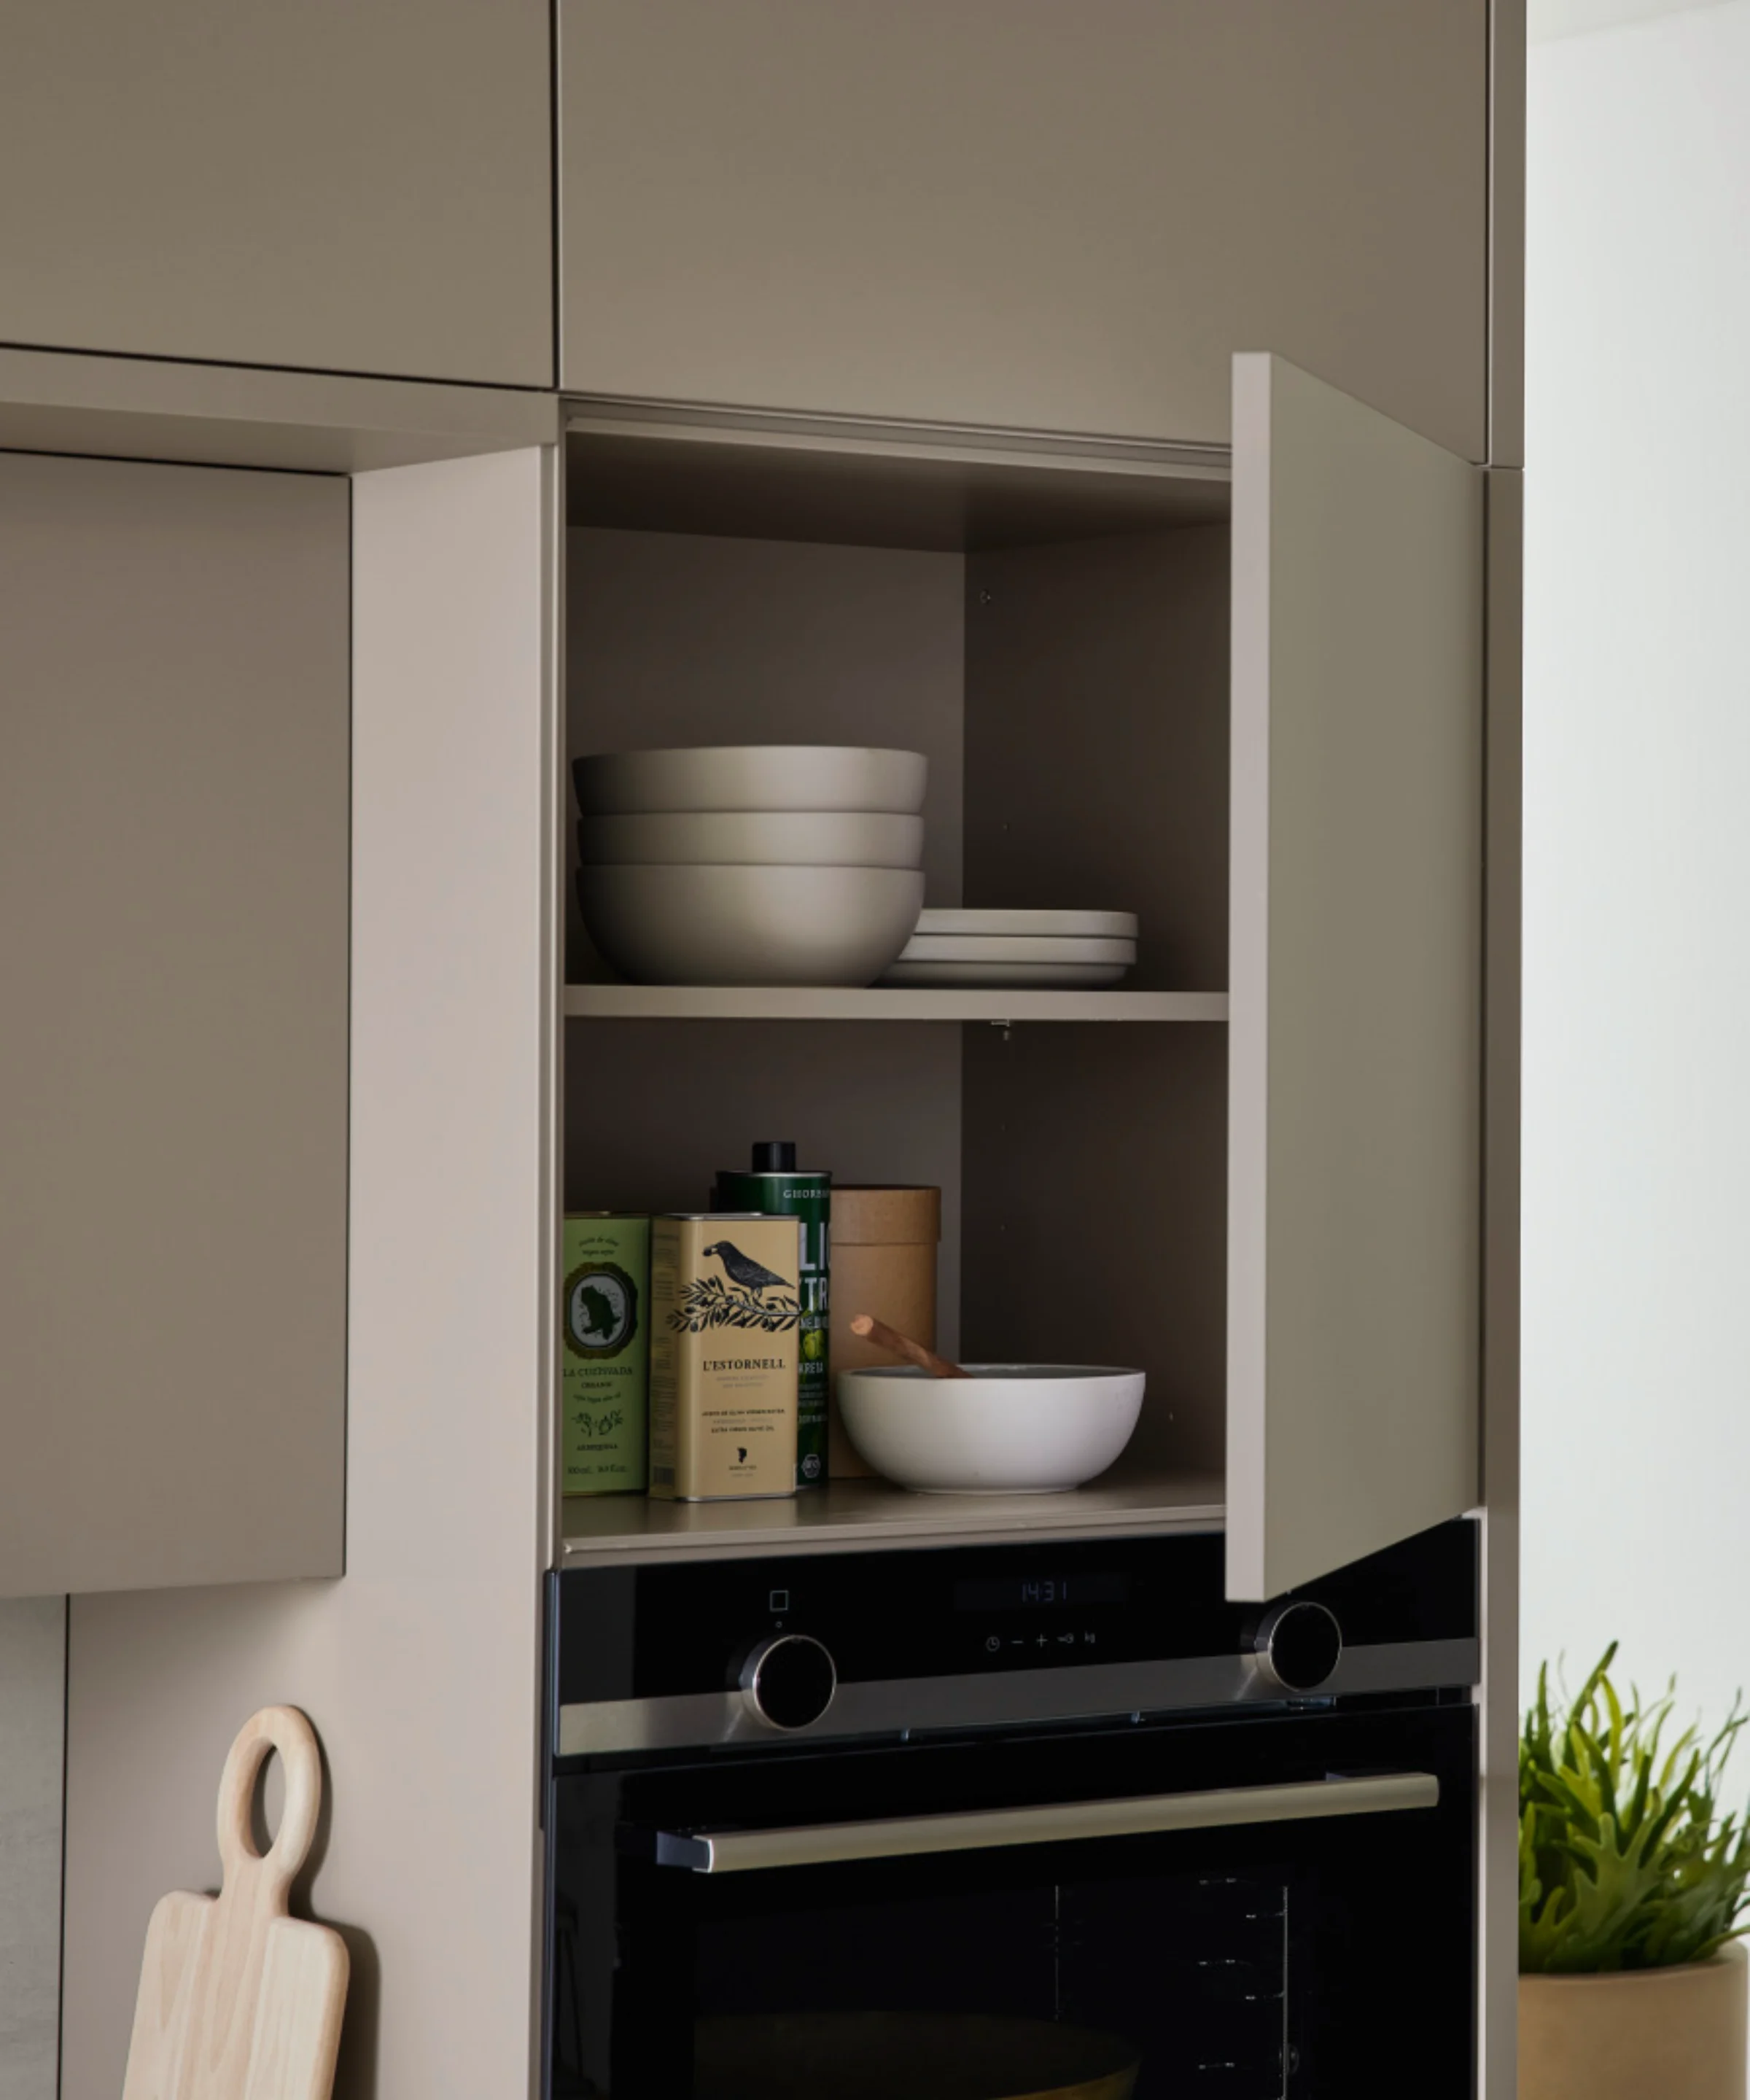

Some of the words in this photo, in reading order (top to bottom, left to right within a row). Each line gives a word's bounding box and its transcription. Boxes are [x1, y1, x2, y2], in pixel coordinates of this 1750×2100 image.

[799, 1222, 830, 1270] LI
[799, 1277, 828, 1312] TR
[563, 1367, 575, 1377] LA
[703, 1358, 786, 1372] L'ESTORNELL
